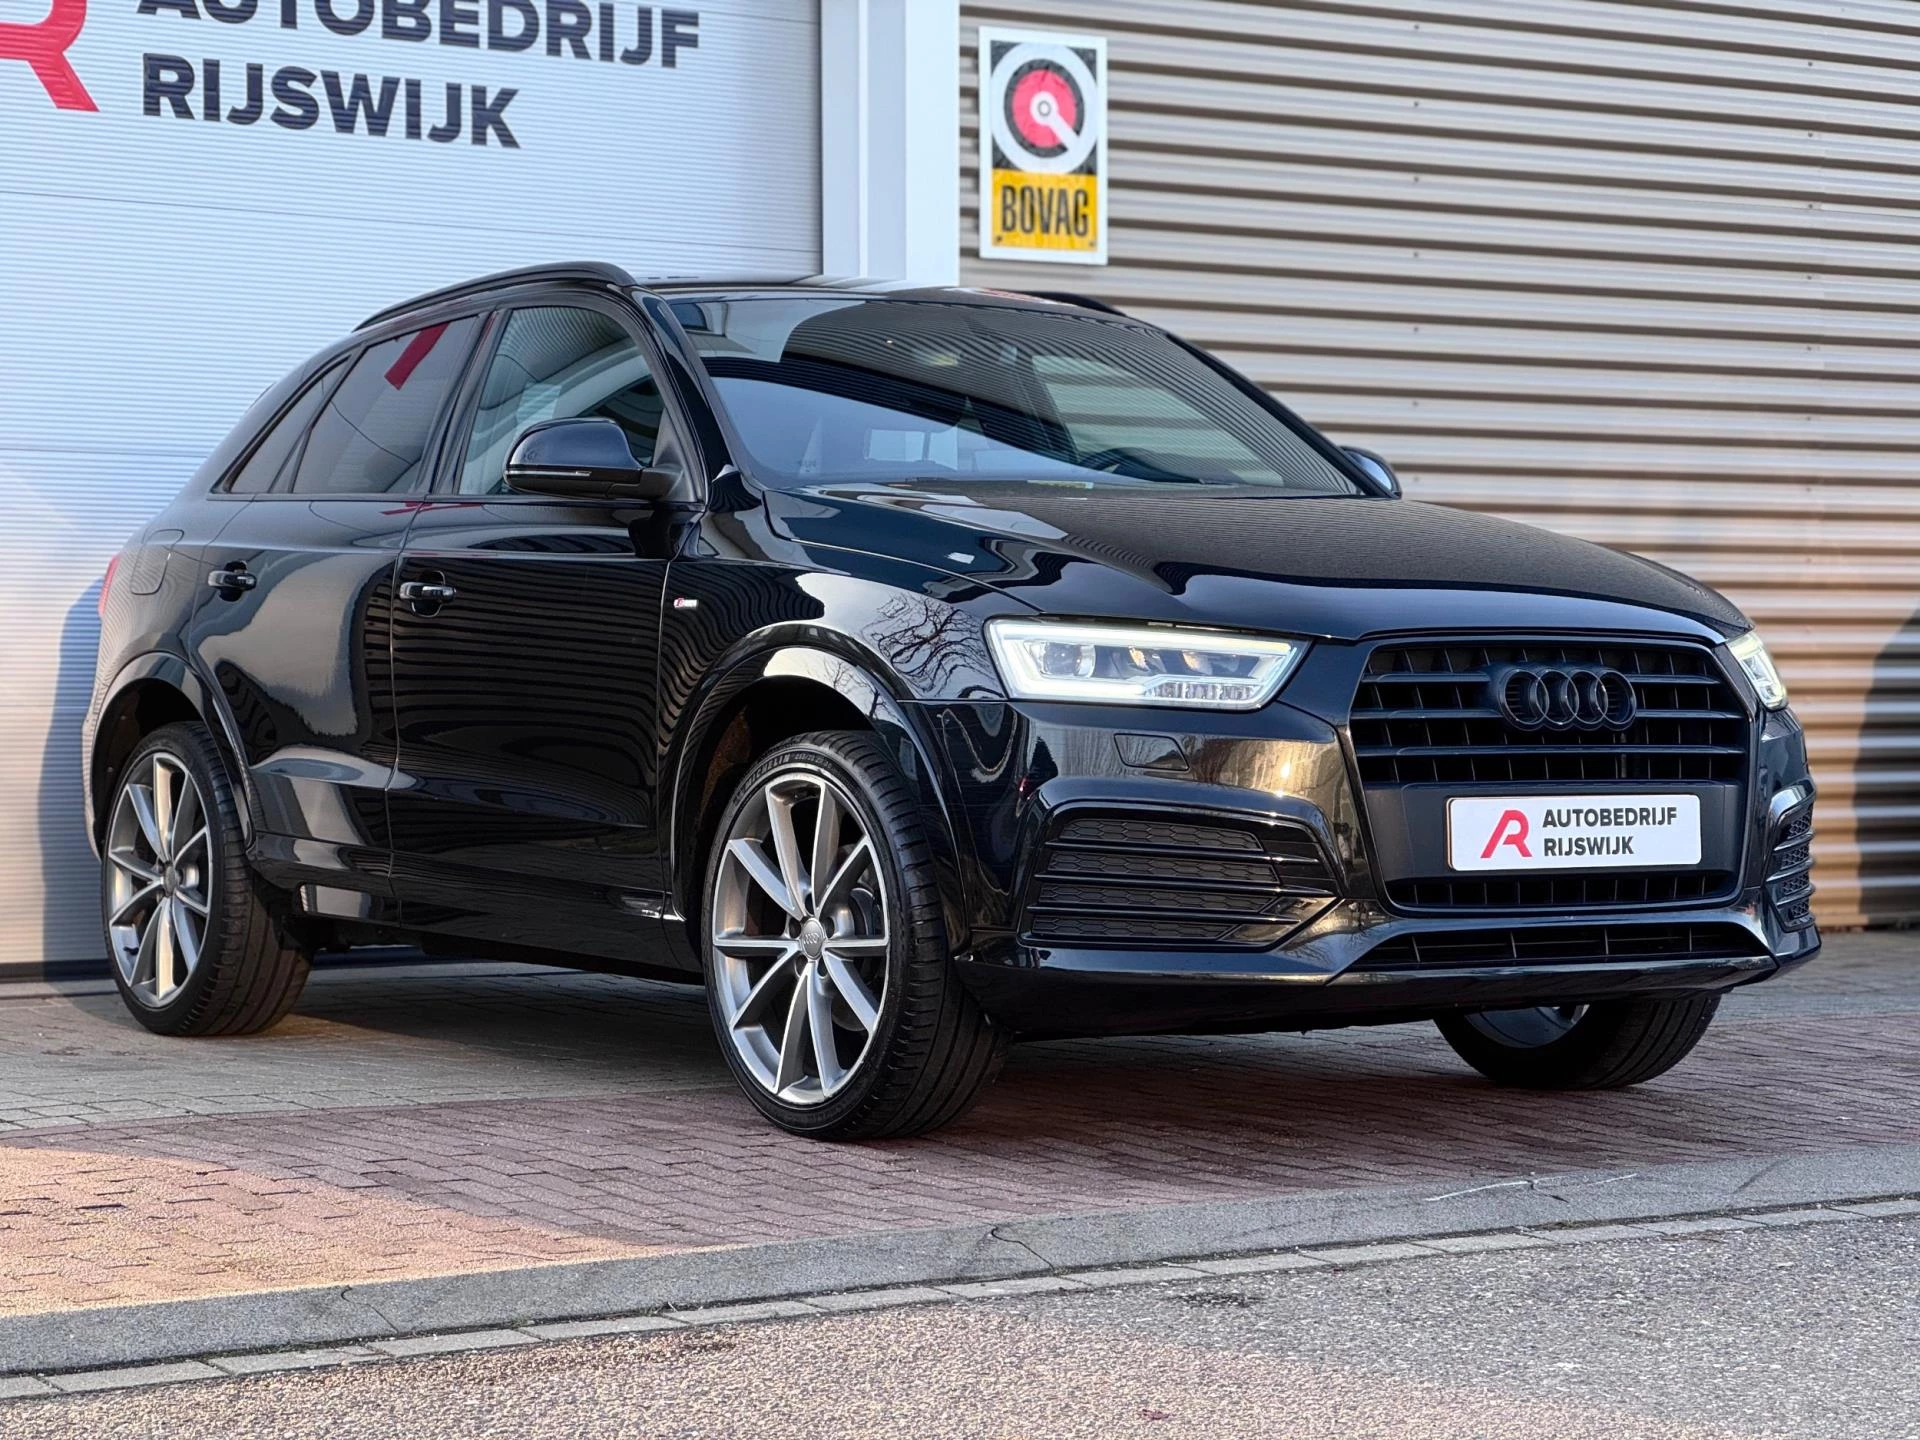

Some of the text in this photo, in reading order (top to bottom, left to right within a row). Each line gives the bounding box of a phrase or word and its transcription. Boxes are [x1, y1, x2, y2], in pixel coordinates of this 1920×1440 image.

[142, 53, 521, 149] RIJSWIJK
[1001, 185, 1089, 237] BOVAG
[743, 753, 792, 791] MICHELIN
[1542, 807, 1678, 828] AUTOBEDRIJF
[1543, 836, 1635, 857] RIJSWIJK
